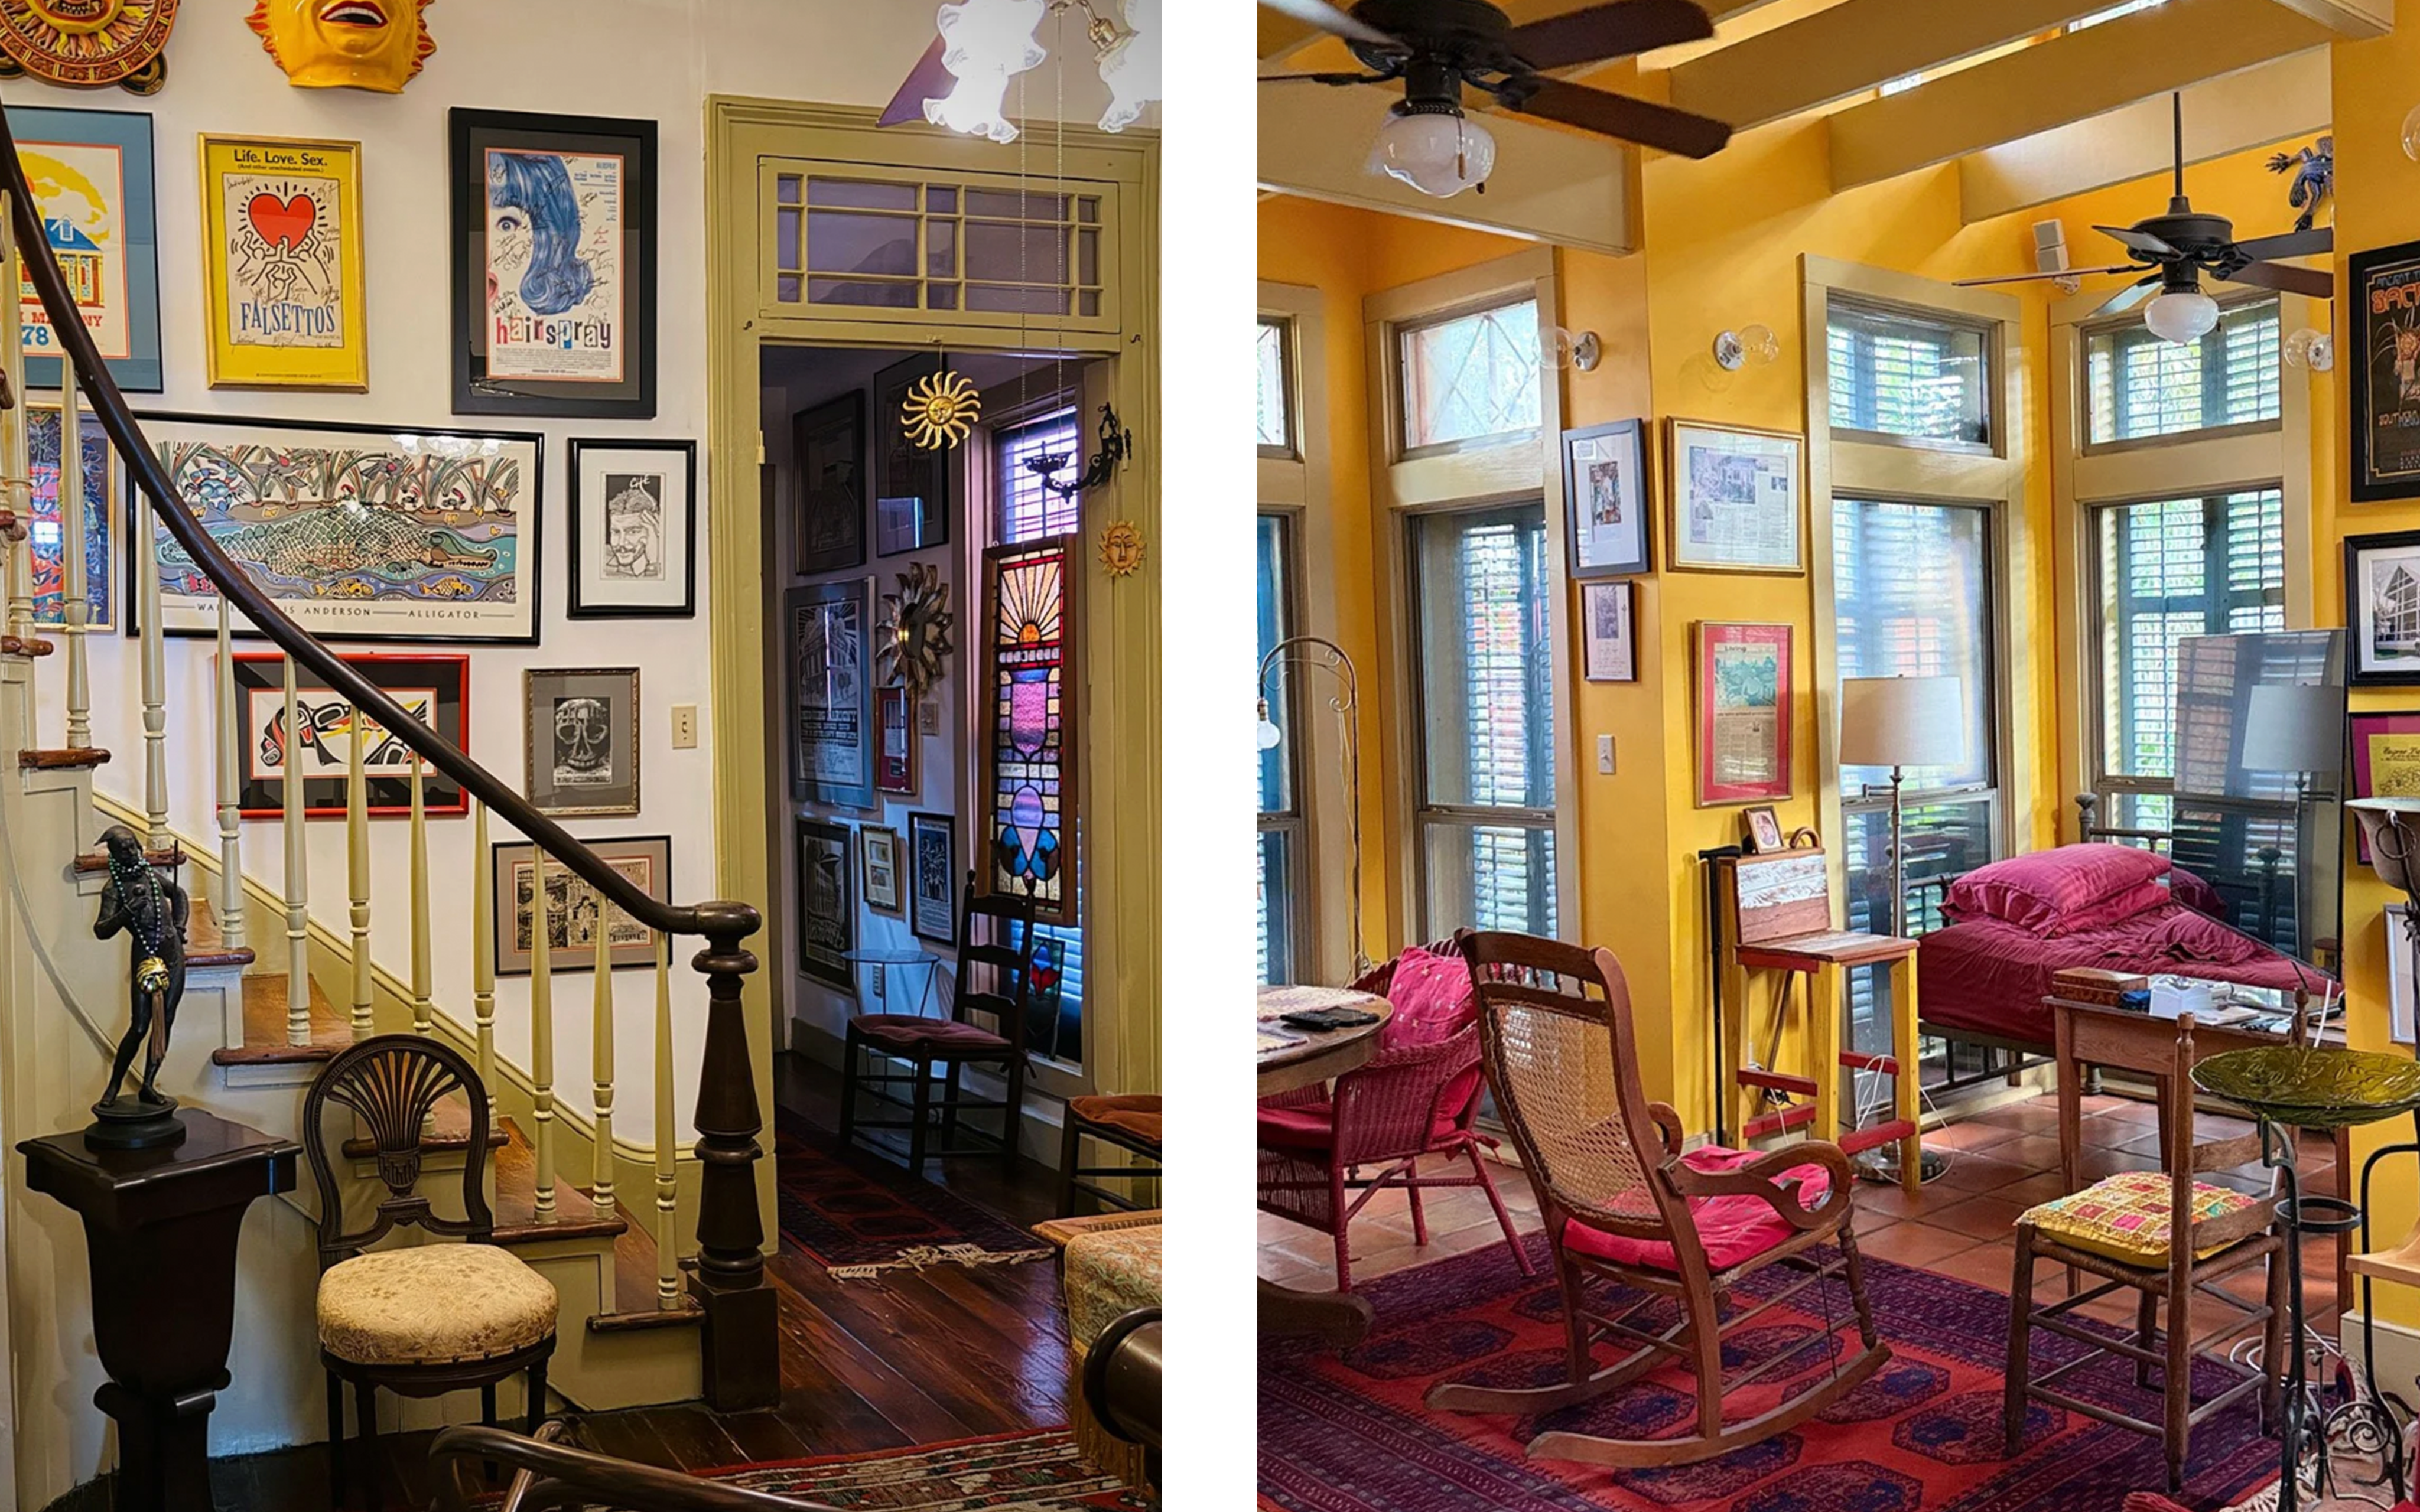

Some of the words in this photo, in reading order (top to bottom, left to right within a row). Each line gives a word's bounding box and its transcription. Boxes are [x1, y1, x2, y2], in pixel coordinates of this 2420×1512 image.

[234, 149, 261, 162] Life.
[265, 151, 297, 164] Love.
[301, 152, 327, 166] Sex.
[240, 299, 335, 336] FALSETTOS
[496, 317, 611, 349] hairspray
[304, 607, 370, 615] ANDERSON
[408, 610, 479, 619] ALLIGATOR
